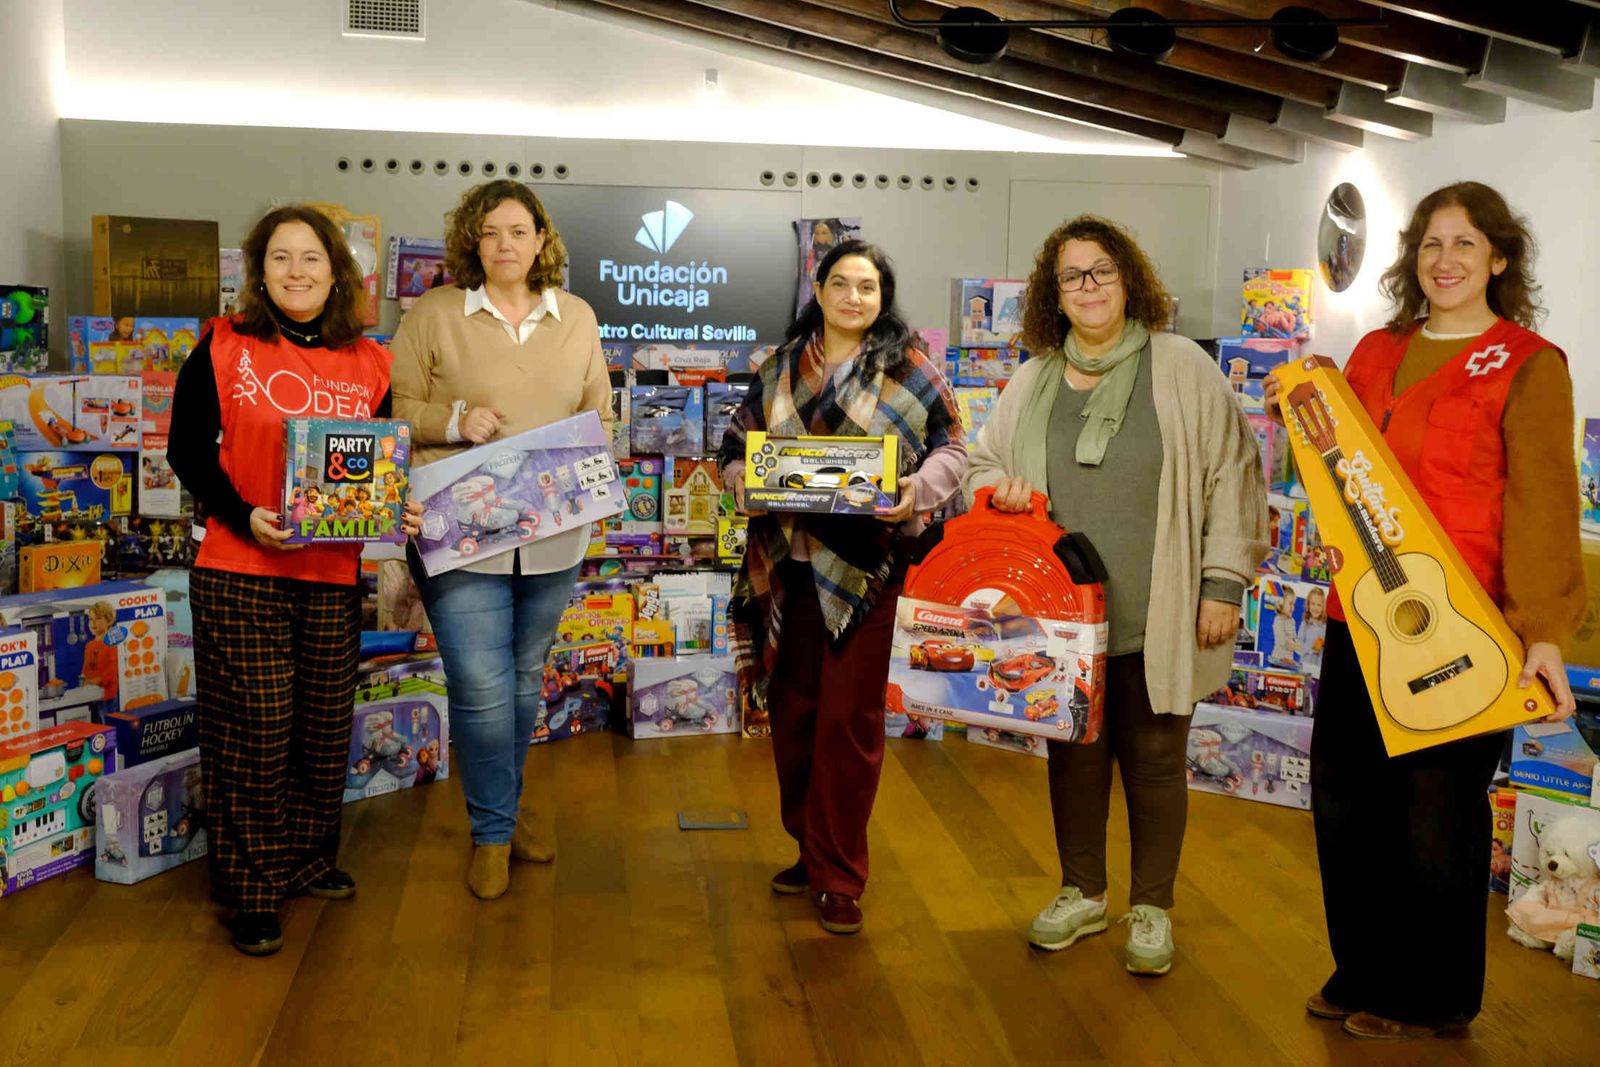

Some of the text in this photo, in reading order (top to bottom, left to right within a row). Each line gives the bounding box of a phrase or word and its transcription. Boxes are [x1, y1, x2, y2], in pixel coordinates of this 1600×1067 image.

[600, 259, 728, 284] Fundación
[617, 283, 709, 313] Unicaja
[598, 323, 757, 342] ntro Cultural Sevilla
[674, 356, 692, 364] Cruz
[694, 356, 711, 365] Roja
[329, 437, 373, 453] PARTY
[1337, 449, 1405, 542] Guitarra
[300, 514, 397, 538] FAMILY
[1360, 508, 1384, 552] madera
[118, 593, 158, 607] COOK'N
[639, 590, 660, 621] Jenga
[134, 605, 159, 619] PLAY
[916, 610, 965, 626] Carrera
[912, 623, 966, 639] SPEED ARENA
[1, 653, 29, 671] PLAY
[141, 727, 184, 749] HOCKEY
[1513, 769, 1540, 781] GENIO
